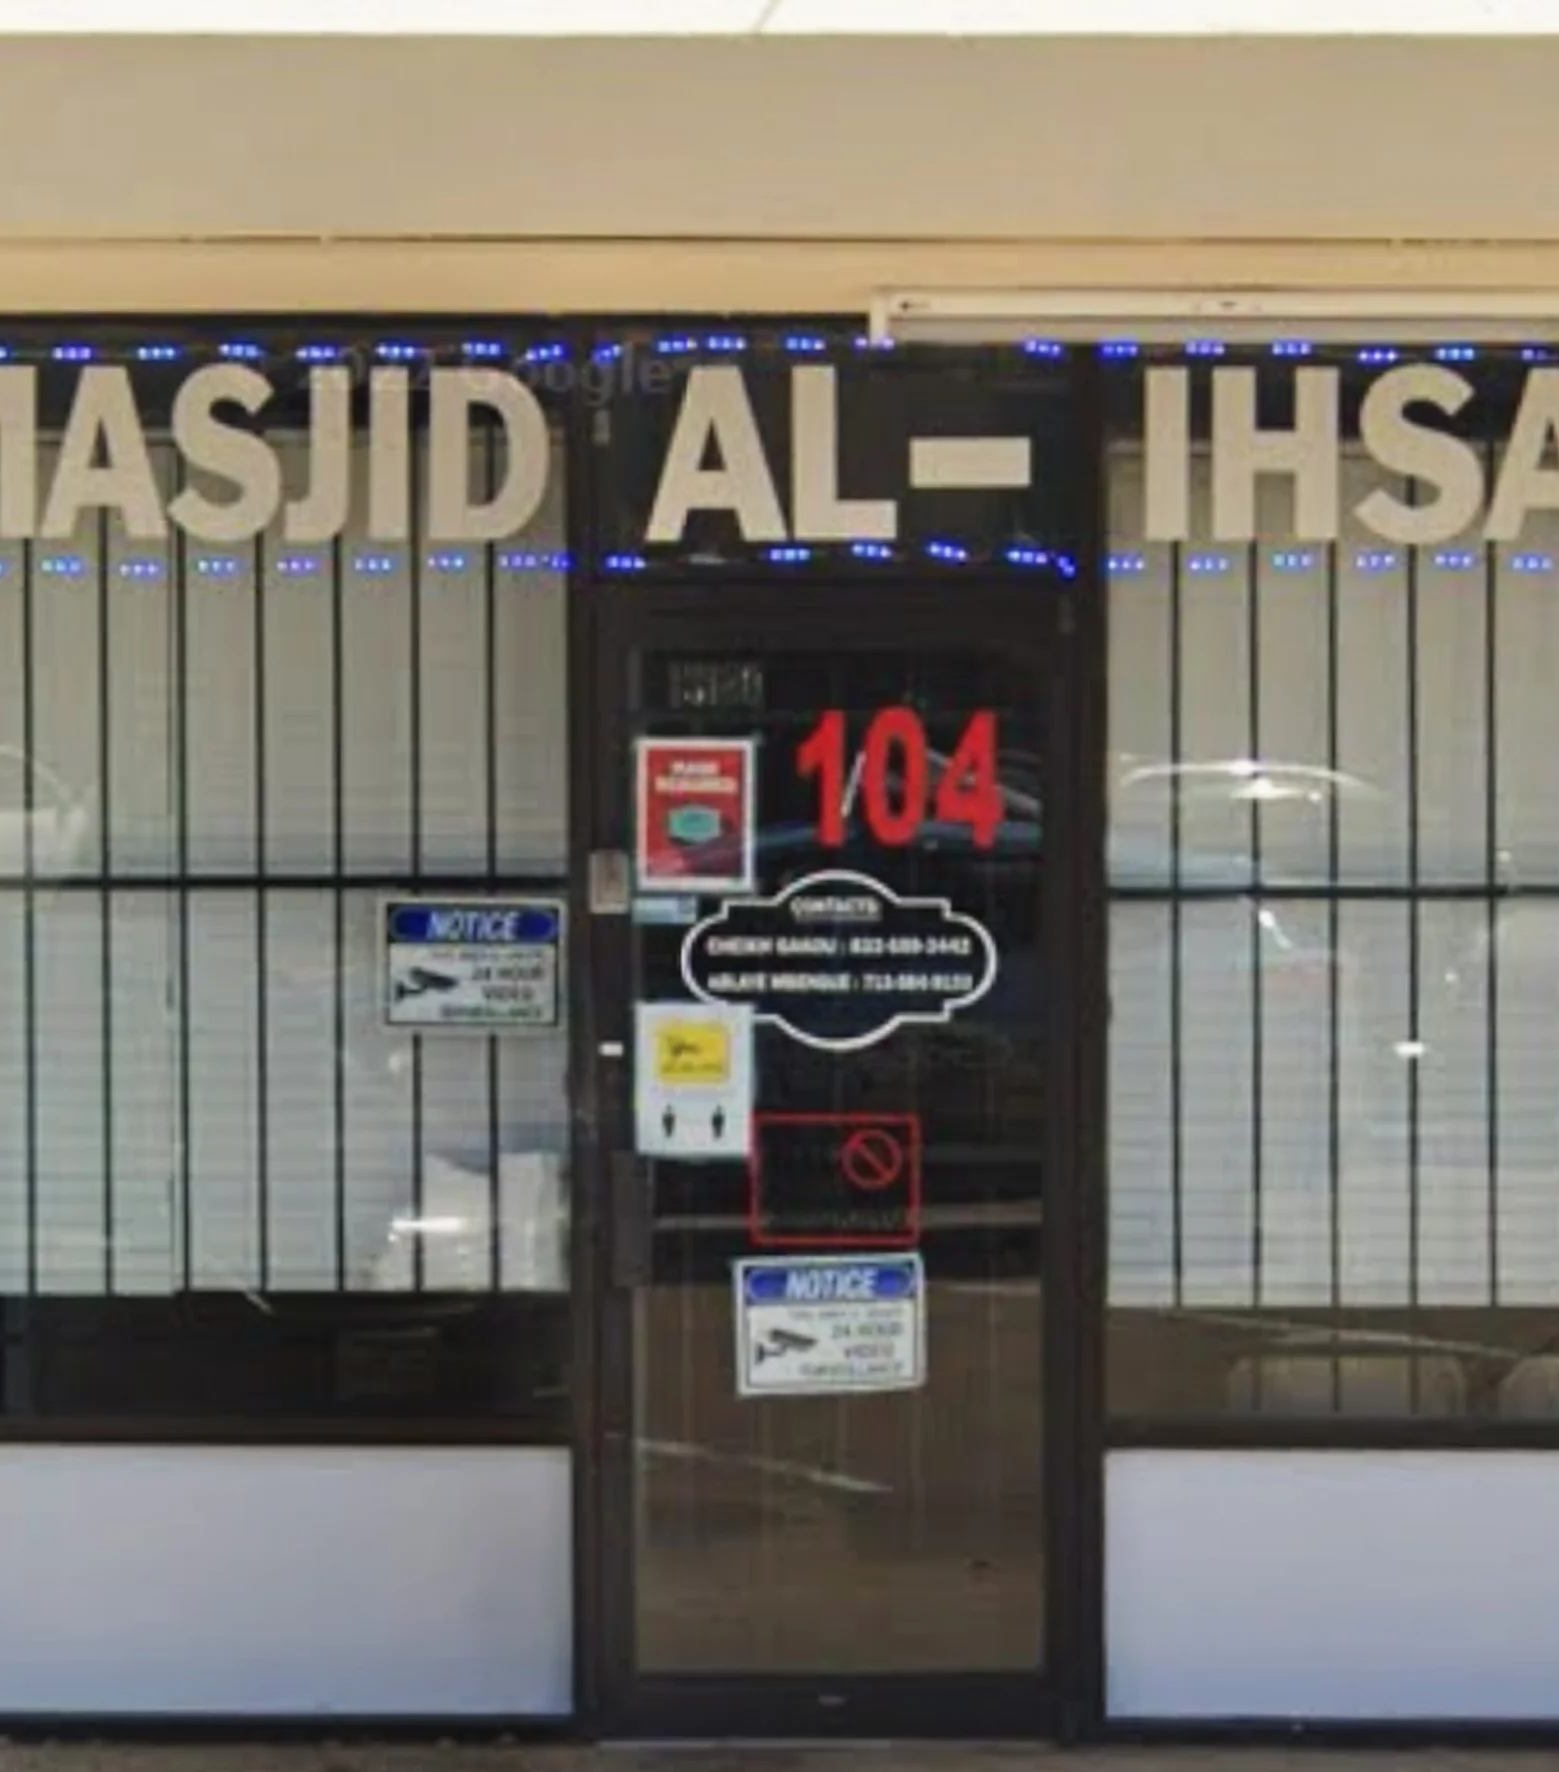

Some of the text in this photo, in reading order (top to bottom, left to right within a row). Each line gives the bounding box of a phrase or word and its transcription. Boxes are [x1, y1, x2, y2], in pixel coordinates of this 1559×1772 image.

[797, 705, 1003, 848] 104
[425, 909, 521, 941] NOTICE
[786, 1267, 879, 1300] NOTICE
